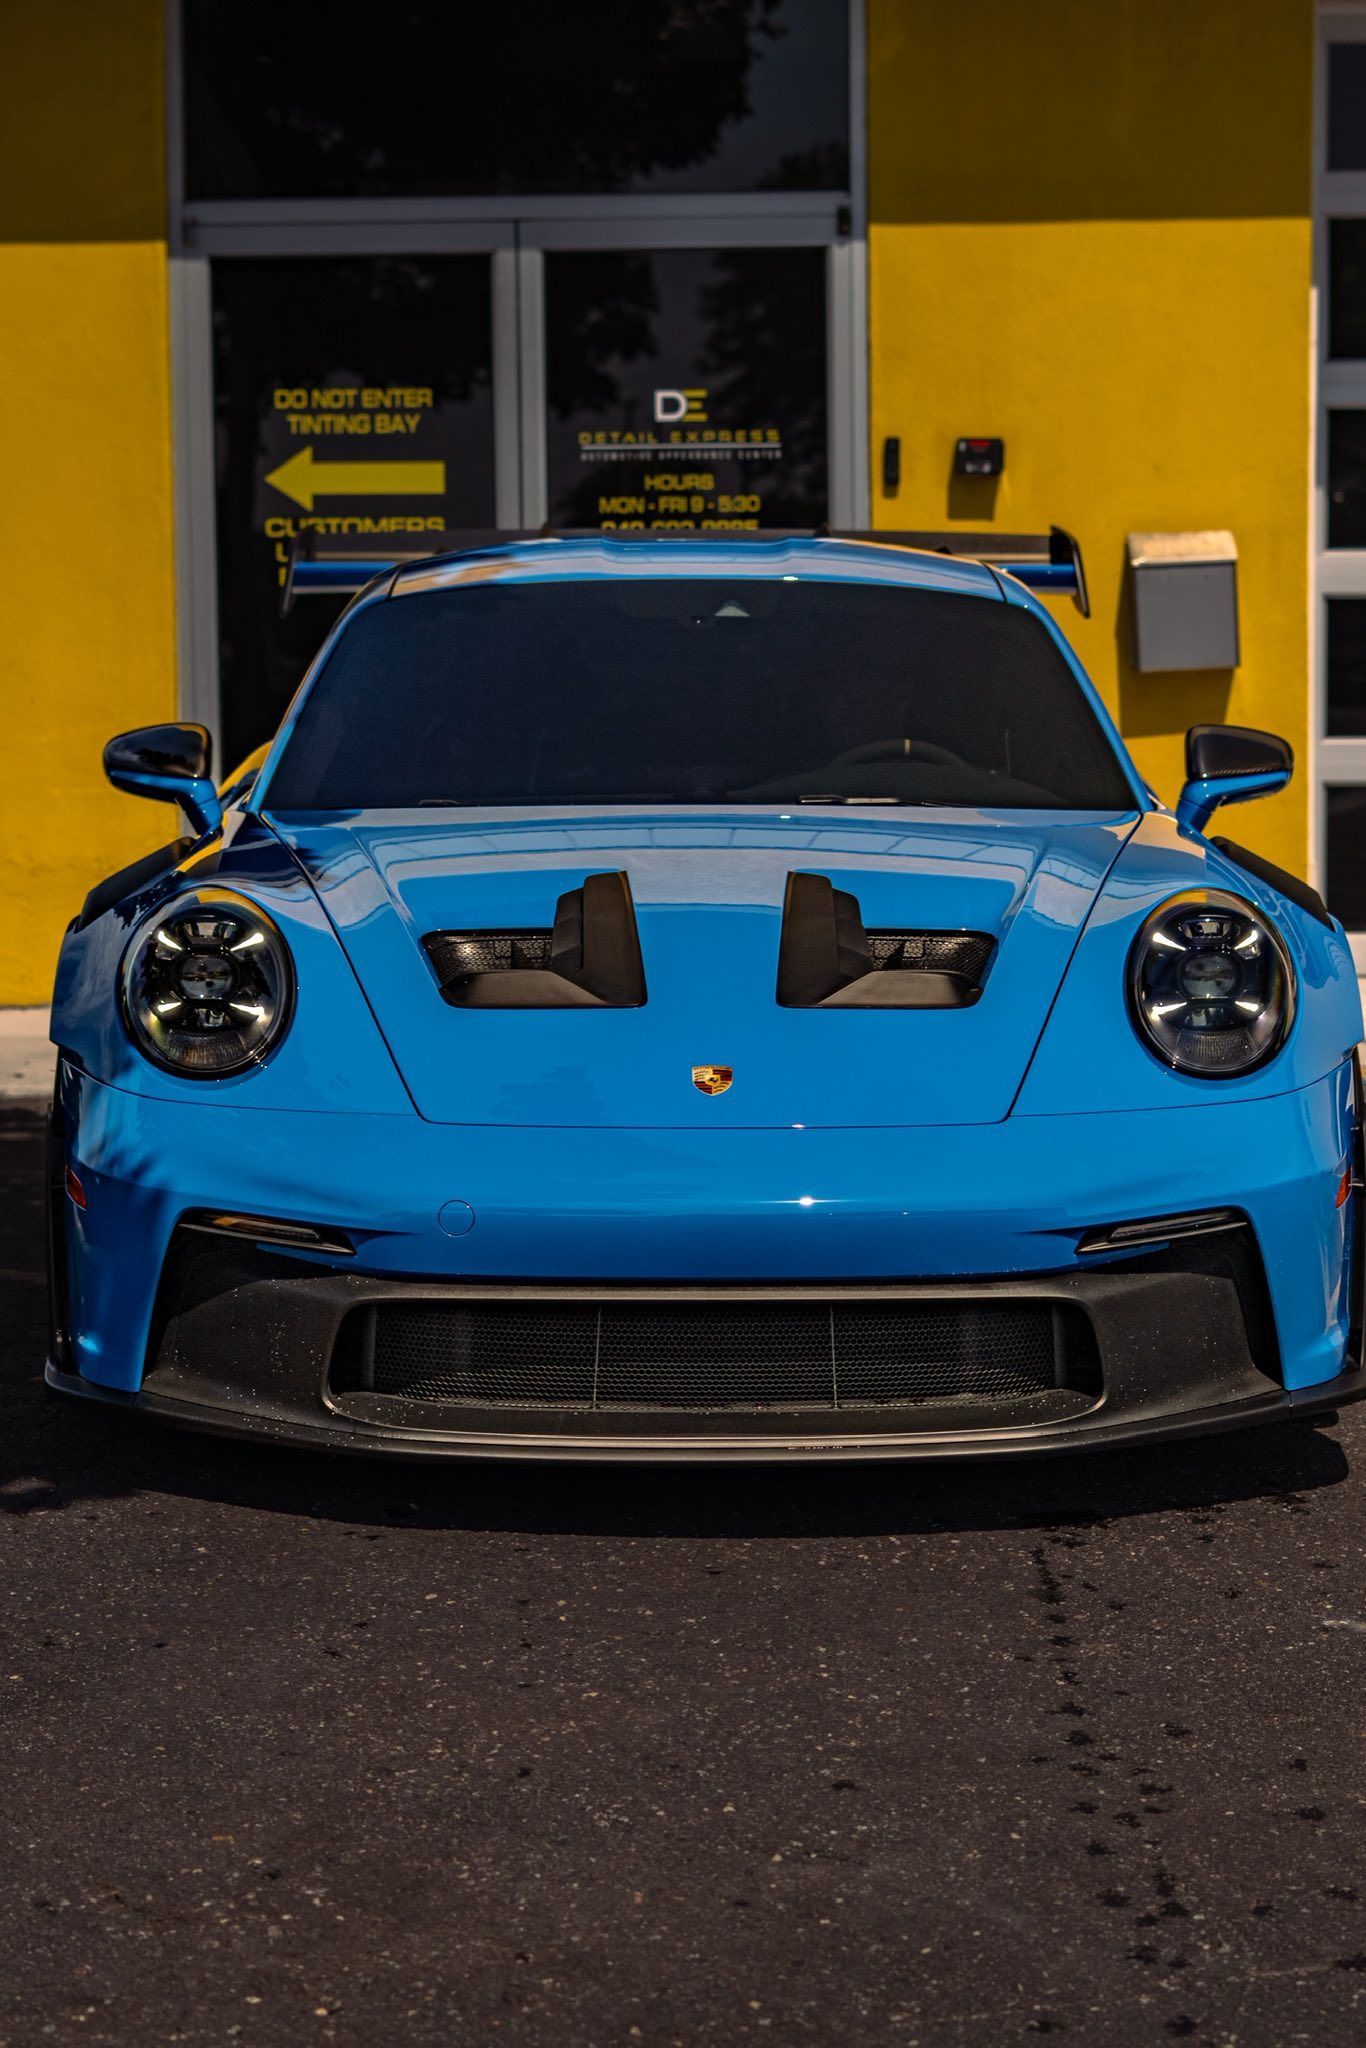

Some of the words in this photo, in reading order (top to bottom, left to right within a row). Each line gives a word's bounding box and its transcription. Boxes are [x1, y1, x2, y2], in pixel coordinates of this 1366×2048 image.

[274, 388, 308, 409] DO
[311, 388, 358, 409] NOT
[361, 388, 433, 409] ENTER
[653, 388, 708, 422] DE
[286, 413, 371, 435] TINTING
[374, 413, 421, 434] BAY
[578, 431, 658, 444] DETAIL
[669, 429, 780, 443] EXPRESS
[644, 473, 715, 491] HOURS
[598, 496, 645, 514] MON
[658, 495, 687, 512] FRI
[690, 495, 704, 513] 9
[718, 494, 761, 513] 5:30
